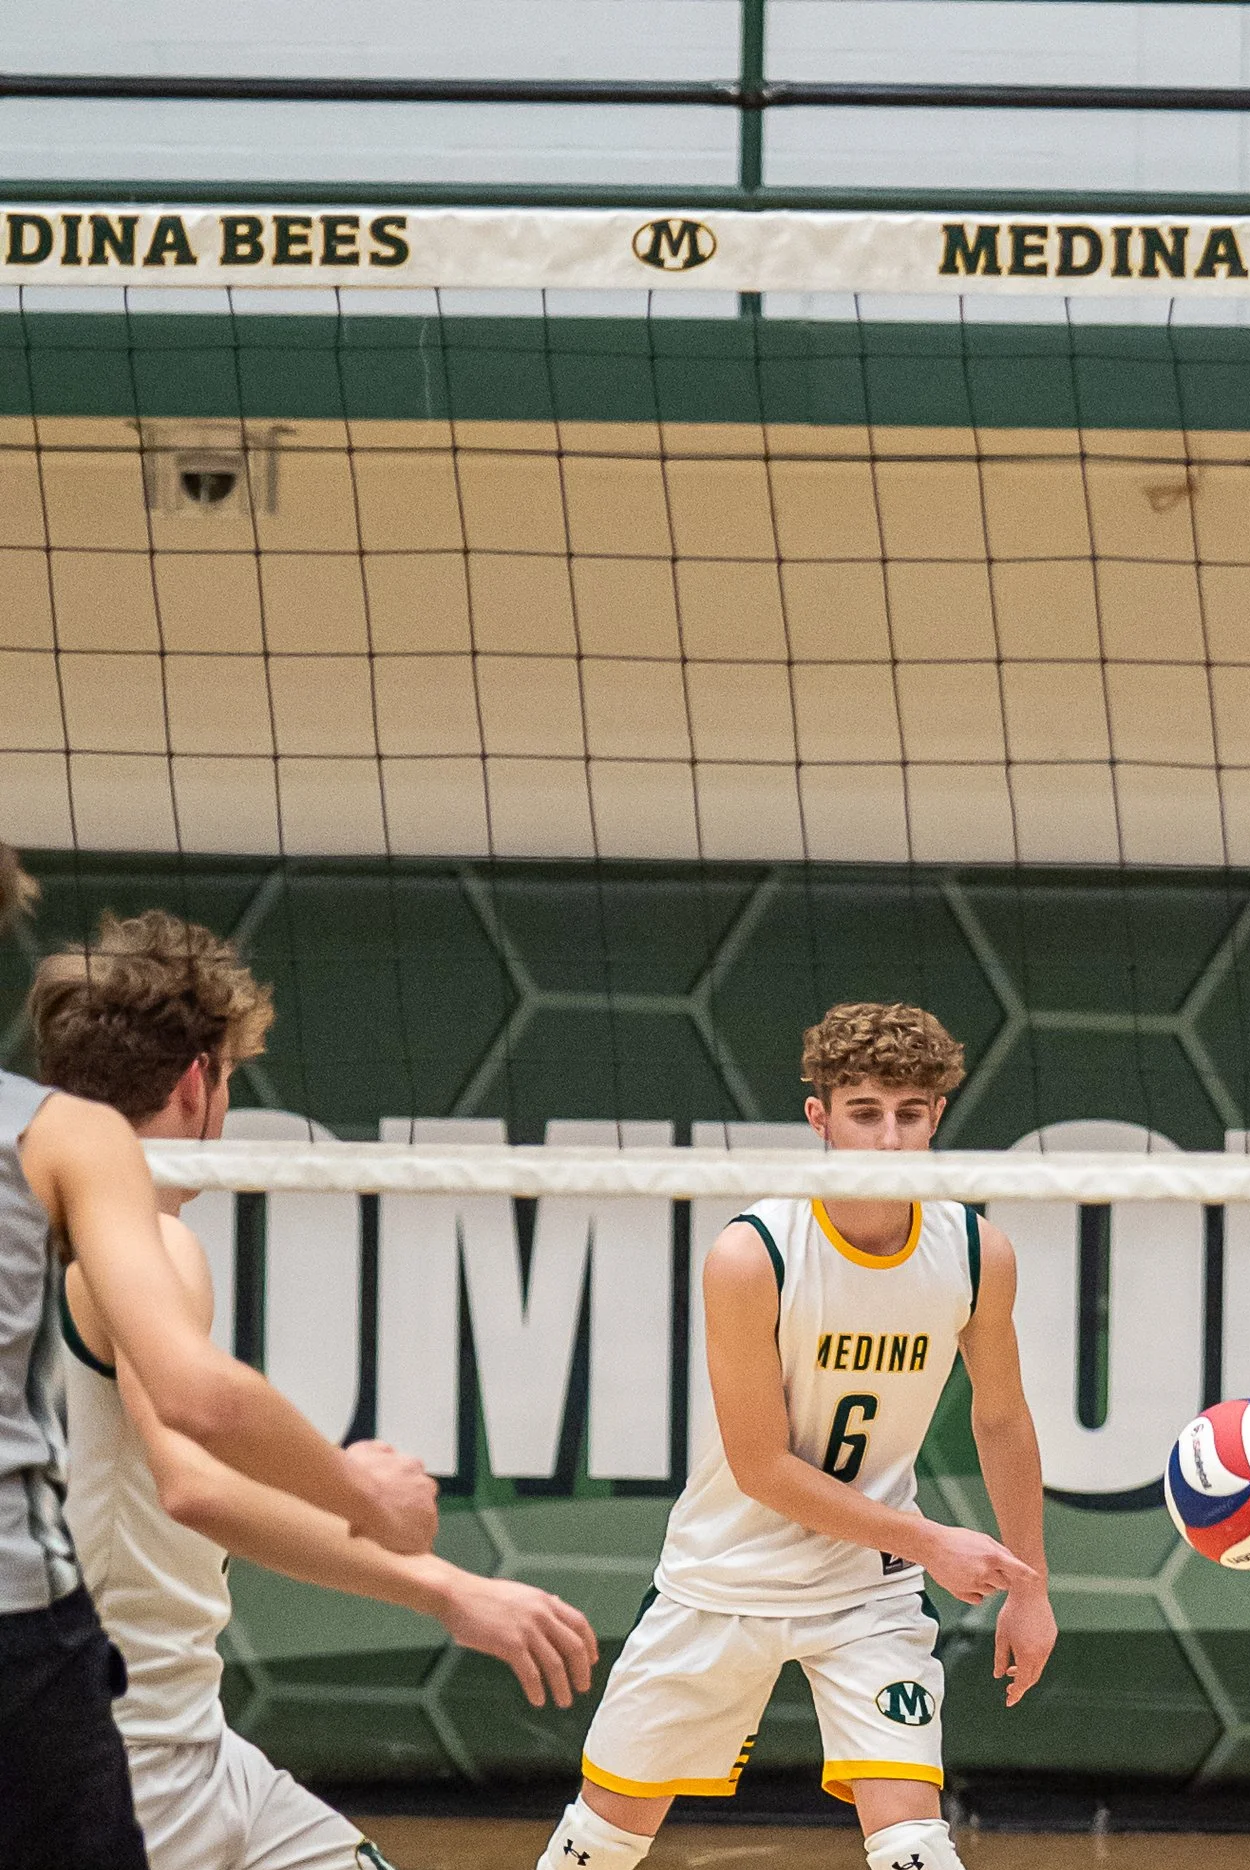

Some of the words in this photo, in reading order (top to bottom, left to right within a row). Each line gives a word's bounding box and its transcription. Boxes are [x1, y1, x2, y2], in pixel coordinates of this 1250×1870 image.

[219, 214, 411, 267] BEES
[638, 219, 708, 269] M
[938, 223, 1250, 278] MEDINA
[822, 1392, 880, 1484] 6
[882, 1681, 933, 1725] M
